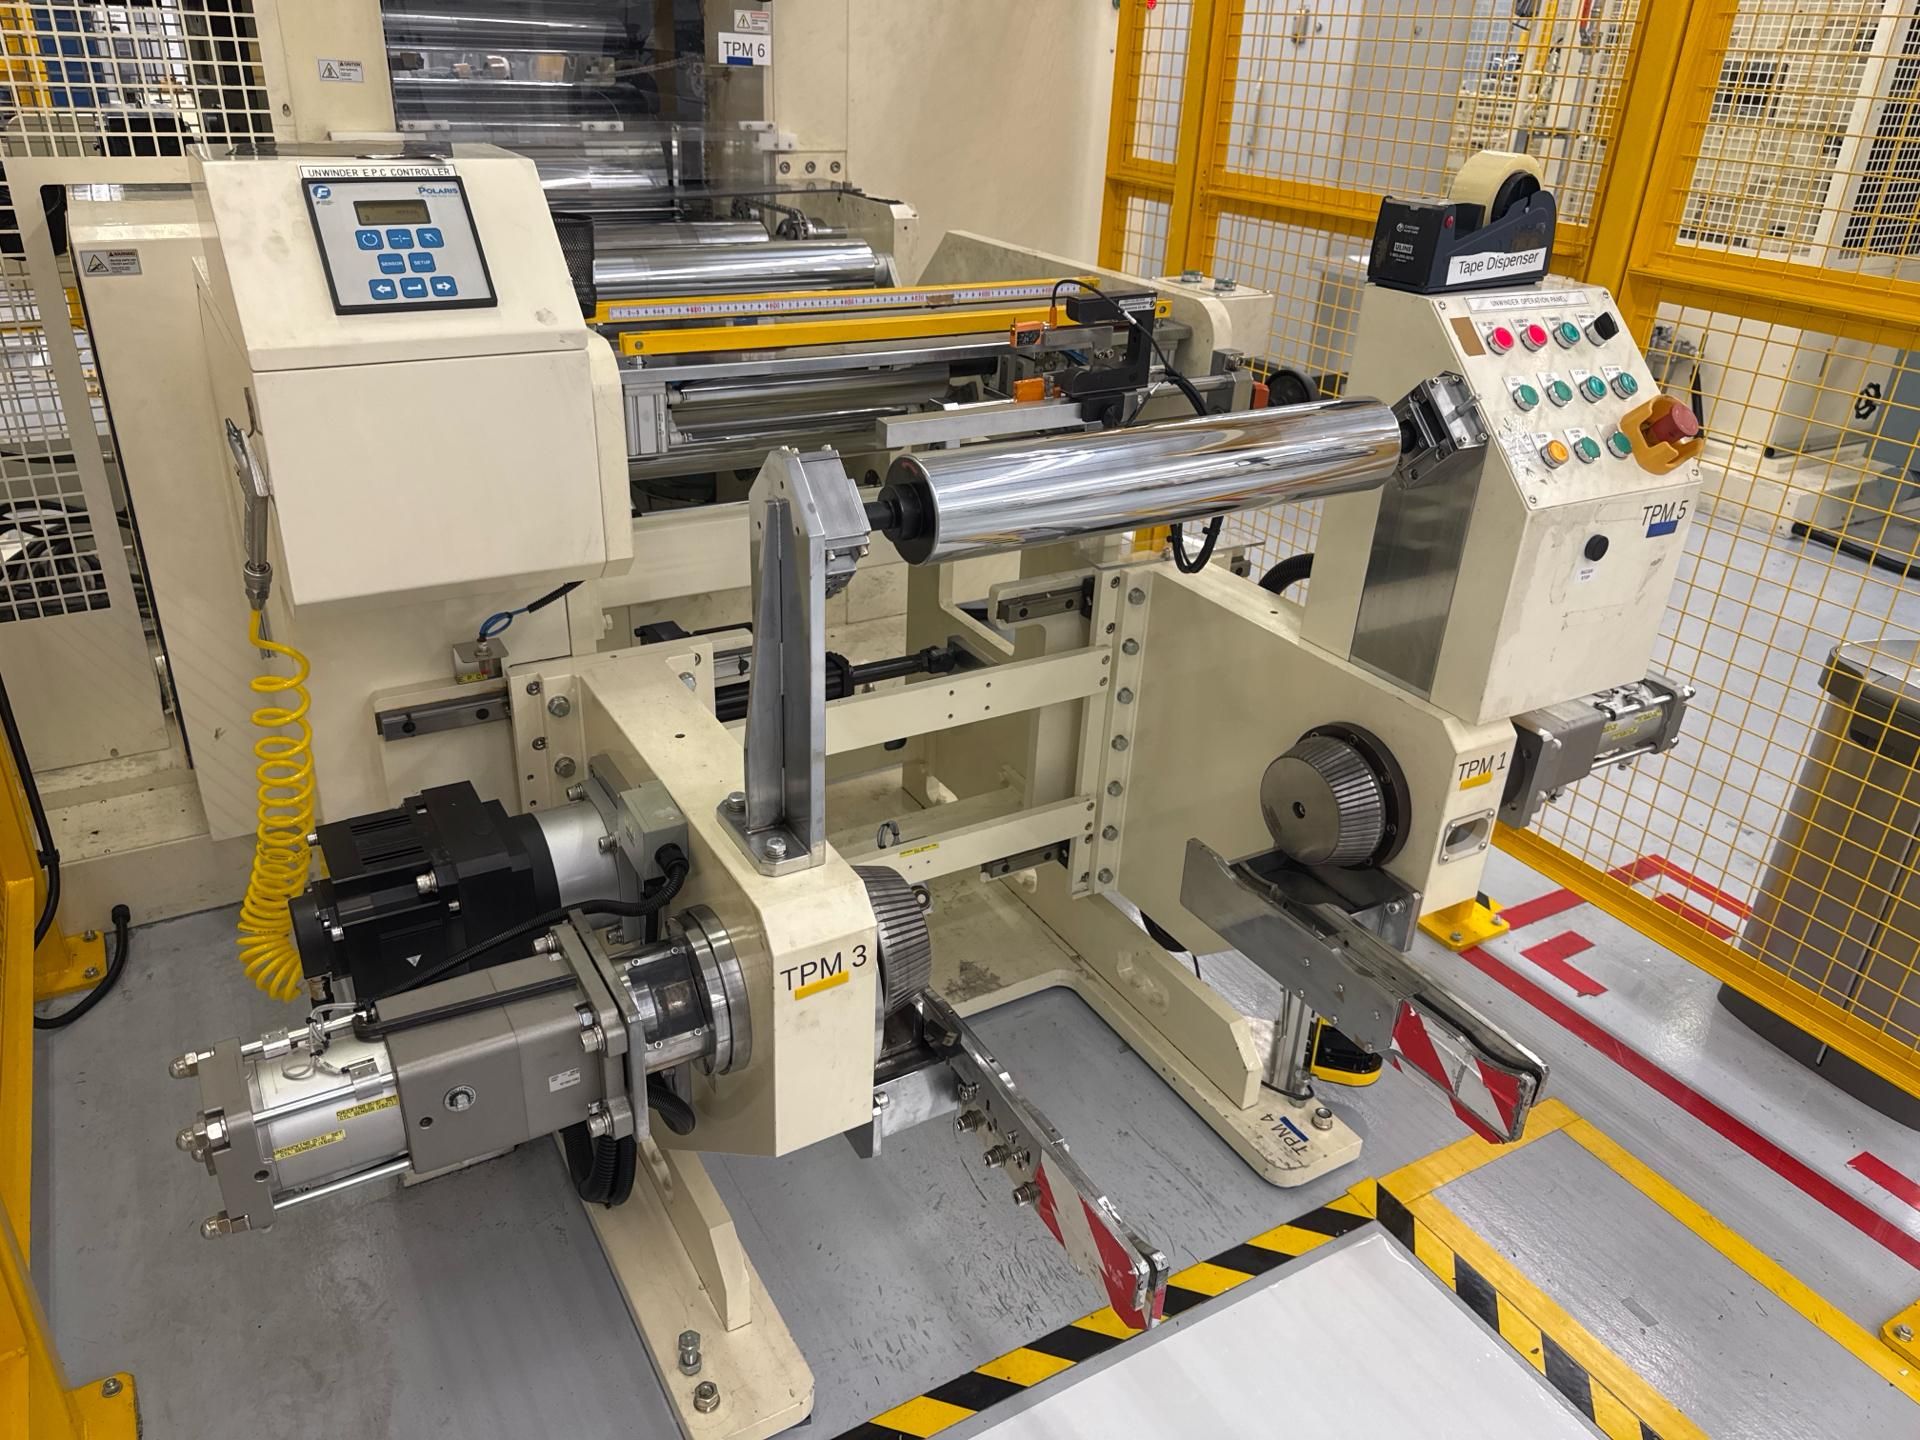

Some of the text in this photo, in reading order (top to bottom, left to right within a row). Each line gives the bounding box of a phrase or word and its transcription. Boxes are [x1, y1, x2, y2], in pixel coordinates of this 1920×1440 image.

[723, 41, 765, 58] TPM 6
[307, 168, 359, 177] UNWINDER
[390, 167, 450, 176] CONTROLLER
[1459, 252, 1539, 276] Tape Dispenser
[1642, 500, 1688, 526] TPM 5
[1459, 752, 1506, 780] TPM 1
[780, 945, 866, 990] TPM 3
[1260, 1113, 1308, 1156] TPM 4
